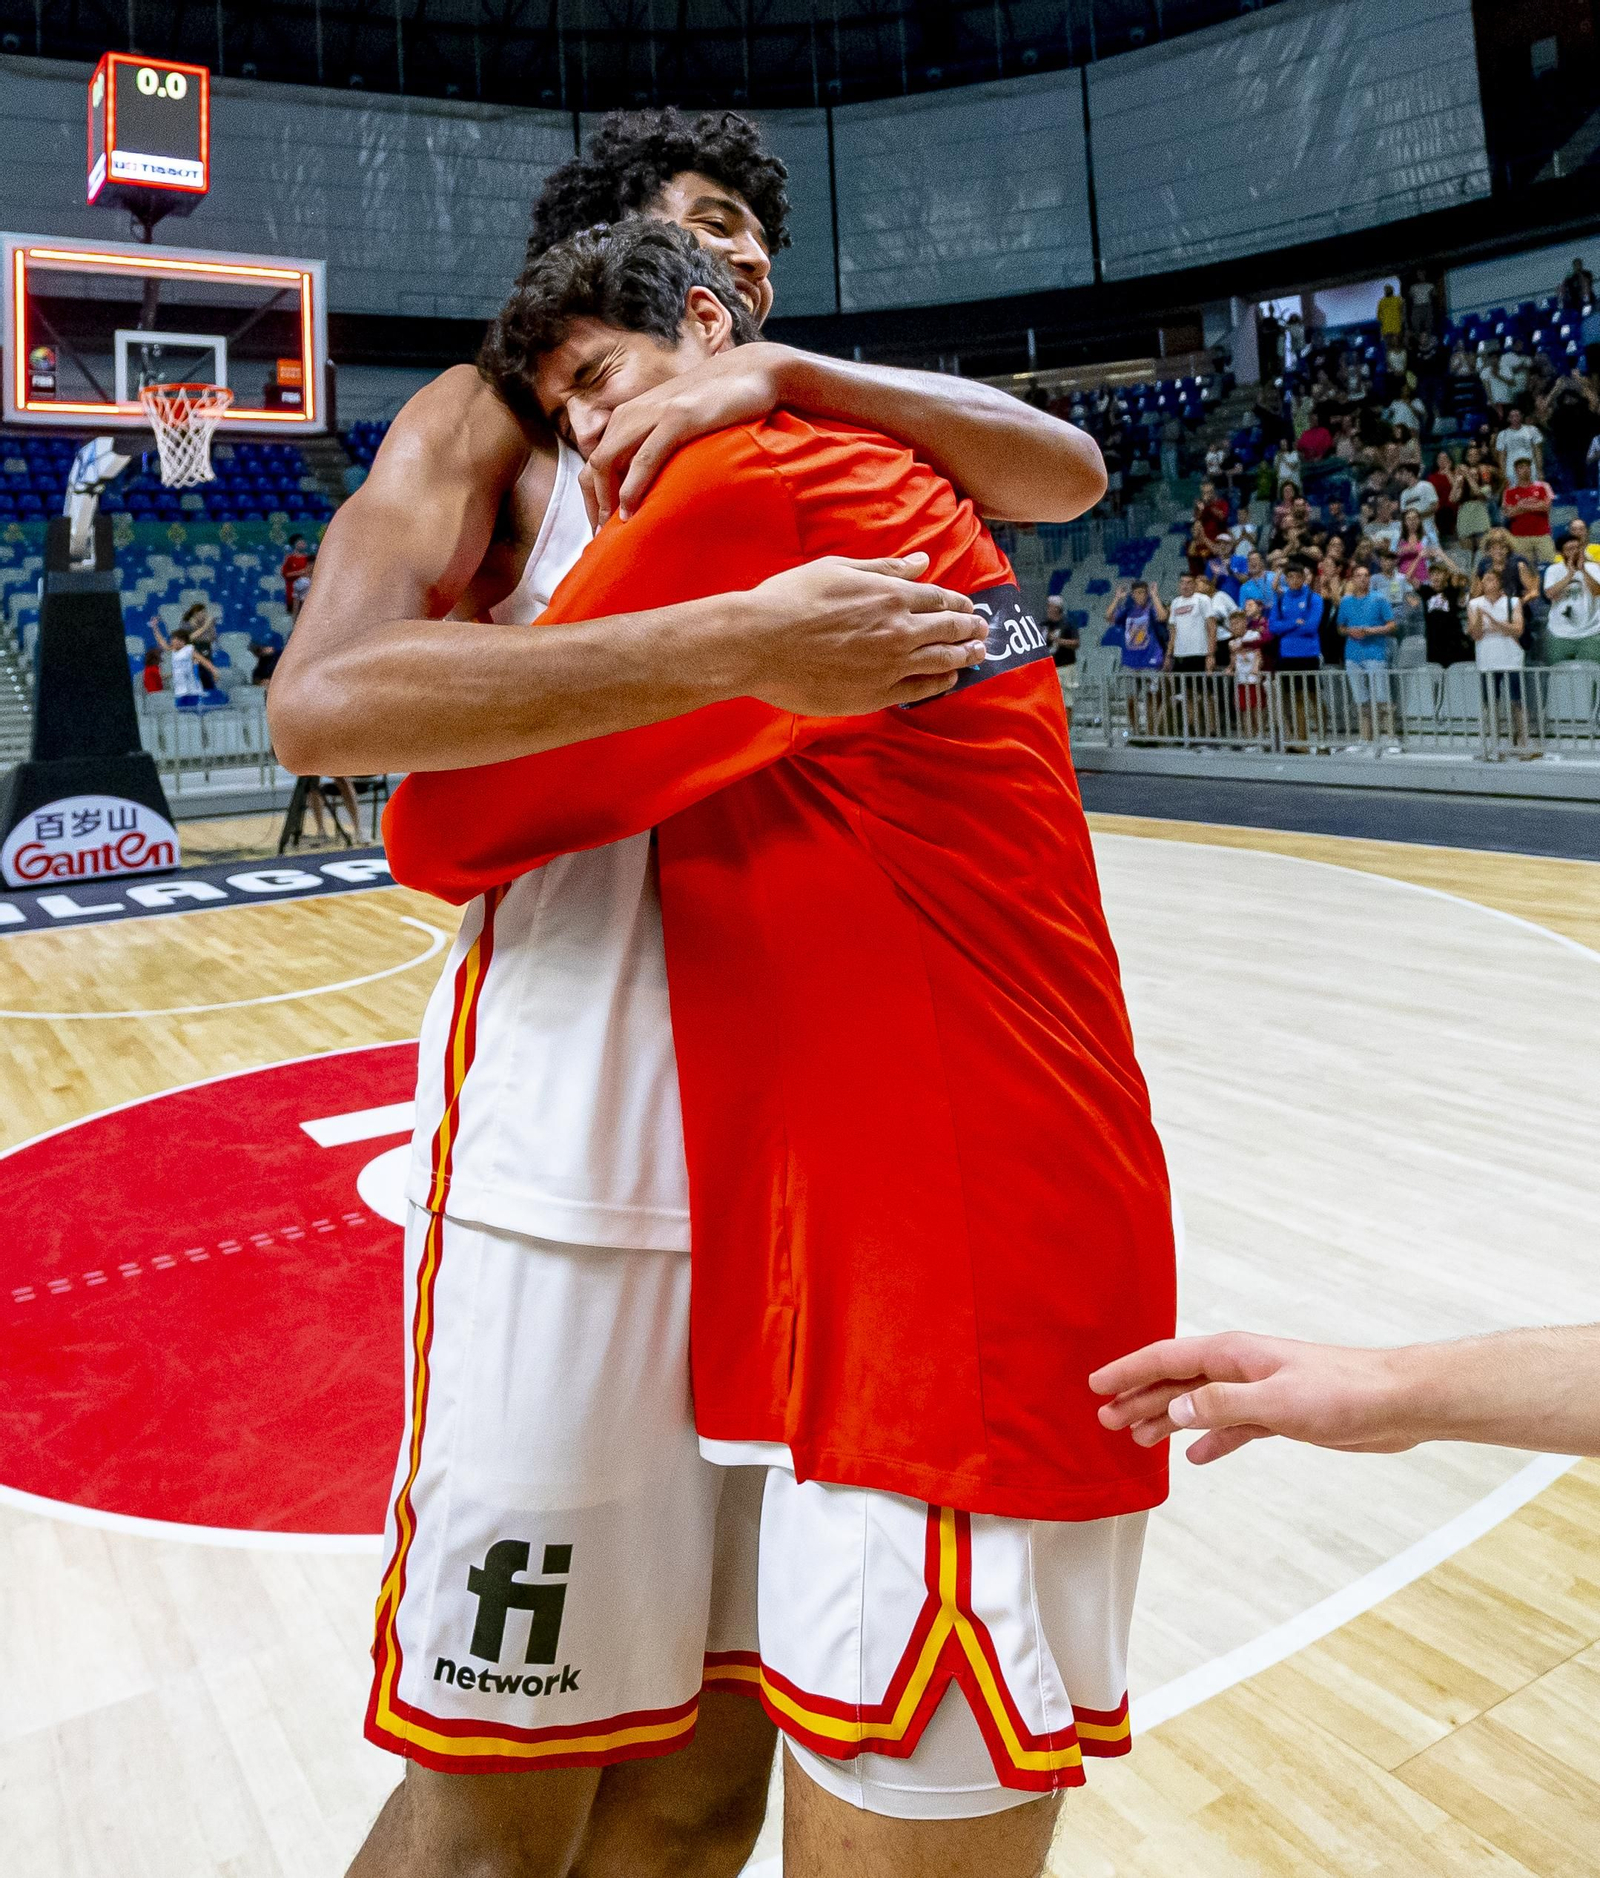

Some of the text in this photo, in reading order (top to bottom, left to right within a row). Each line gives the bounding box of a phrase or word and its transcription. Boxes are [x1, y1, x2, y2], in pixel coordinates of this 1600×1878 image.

[136, 67, 187, 100] 0.0
[35, 805, 139, 841] 百岁山
[0, 858, 391, 926] LAGA
[467, 1539, 573, 1665] fi
[433, 1656, 582, 1697] network
